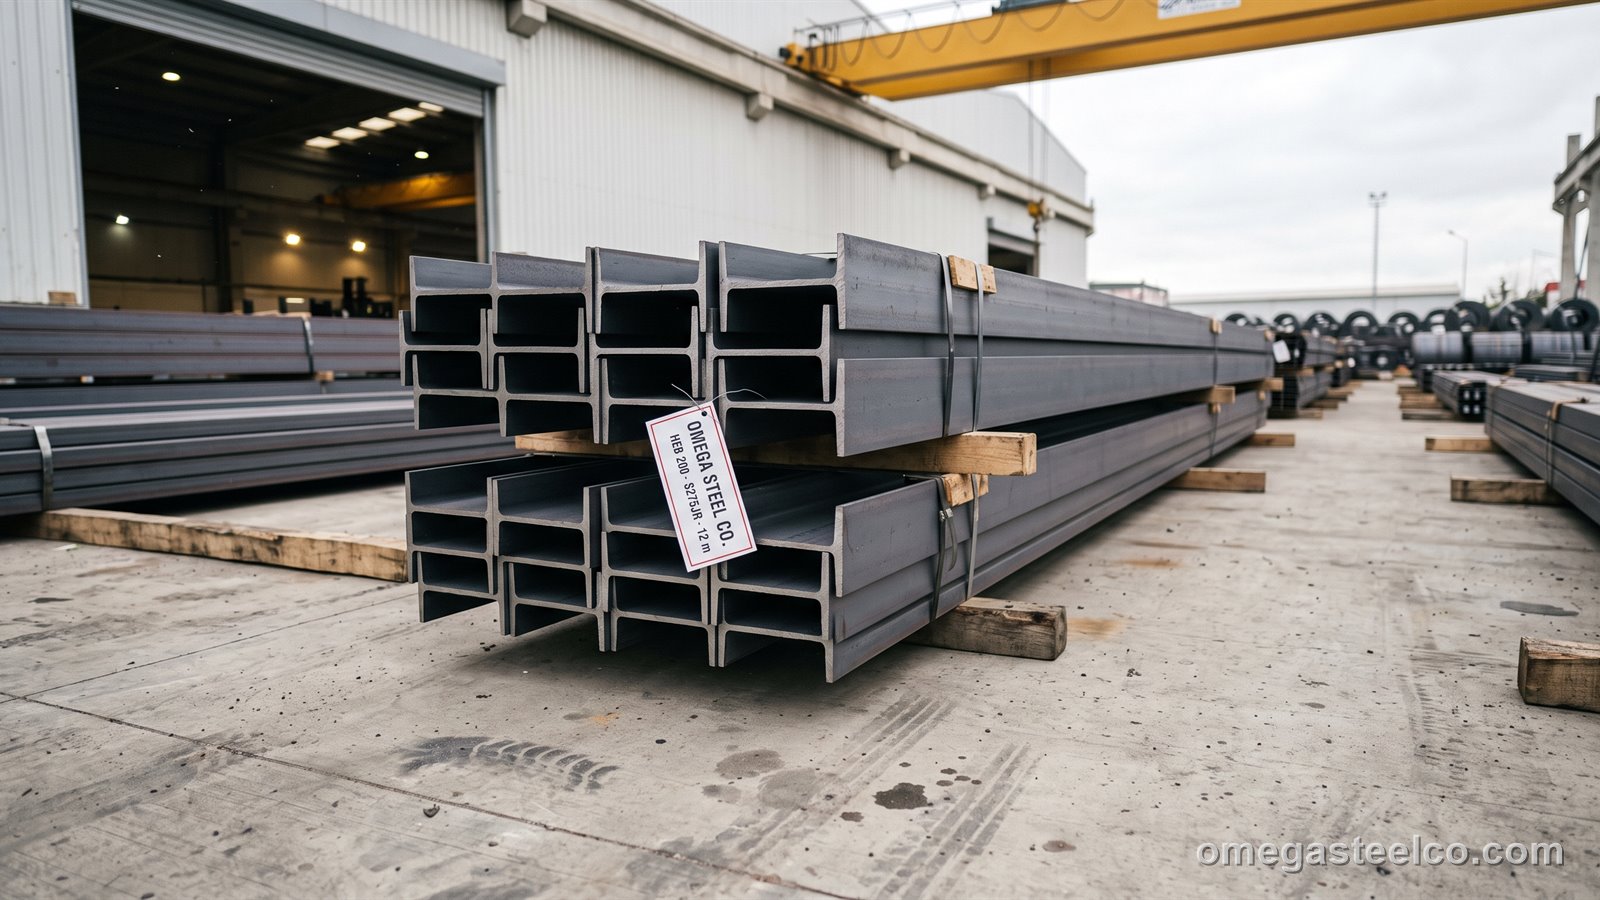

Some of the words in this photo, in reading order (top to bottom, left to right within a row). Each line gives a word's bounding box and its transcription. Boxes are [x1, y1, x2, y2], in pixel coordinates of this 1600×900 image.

[669, 433, 684, 455] HEB
[676, 456, 690, 475] 200
[687, 421, 714, 472] OMEGA
[703, 474, 727, 519] STEEL
[716, 520, 735, 547] CO.
[684, 482, 703, 521] S275JR
[697, 528, 709, 541] 12
[701, 544, 711, 554] m
